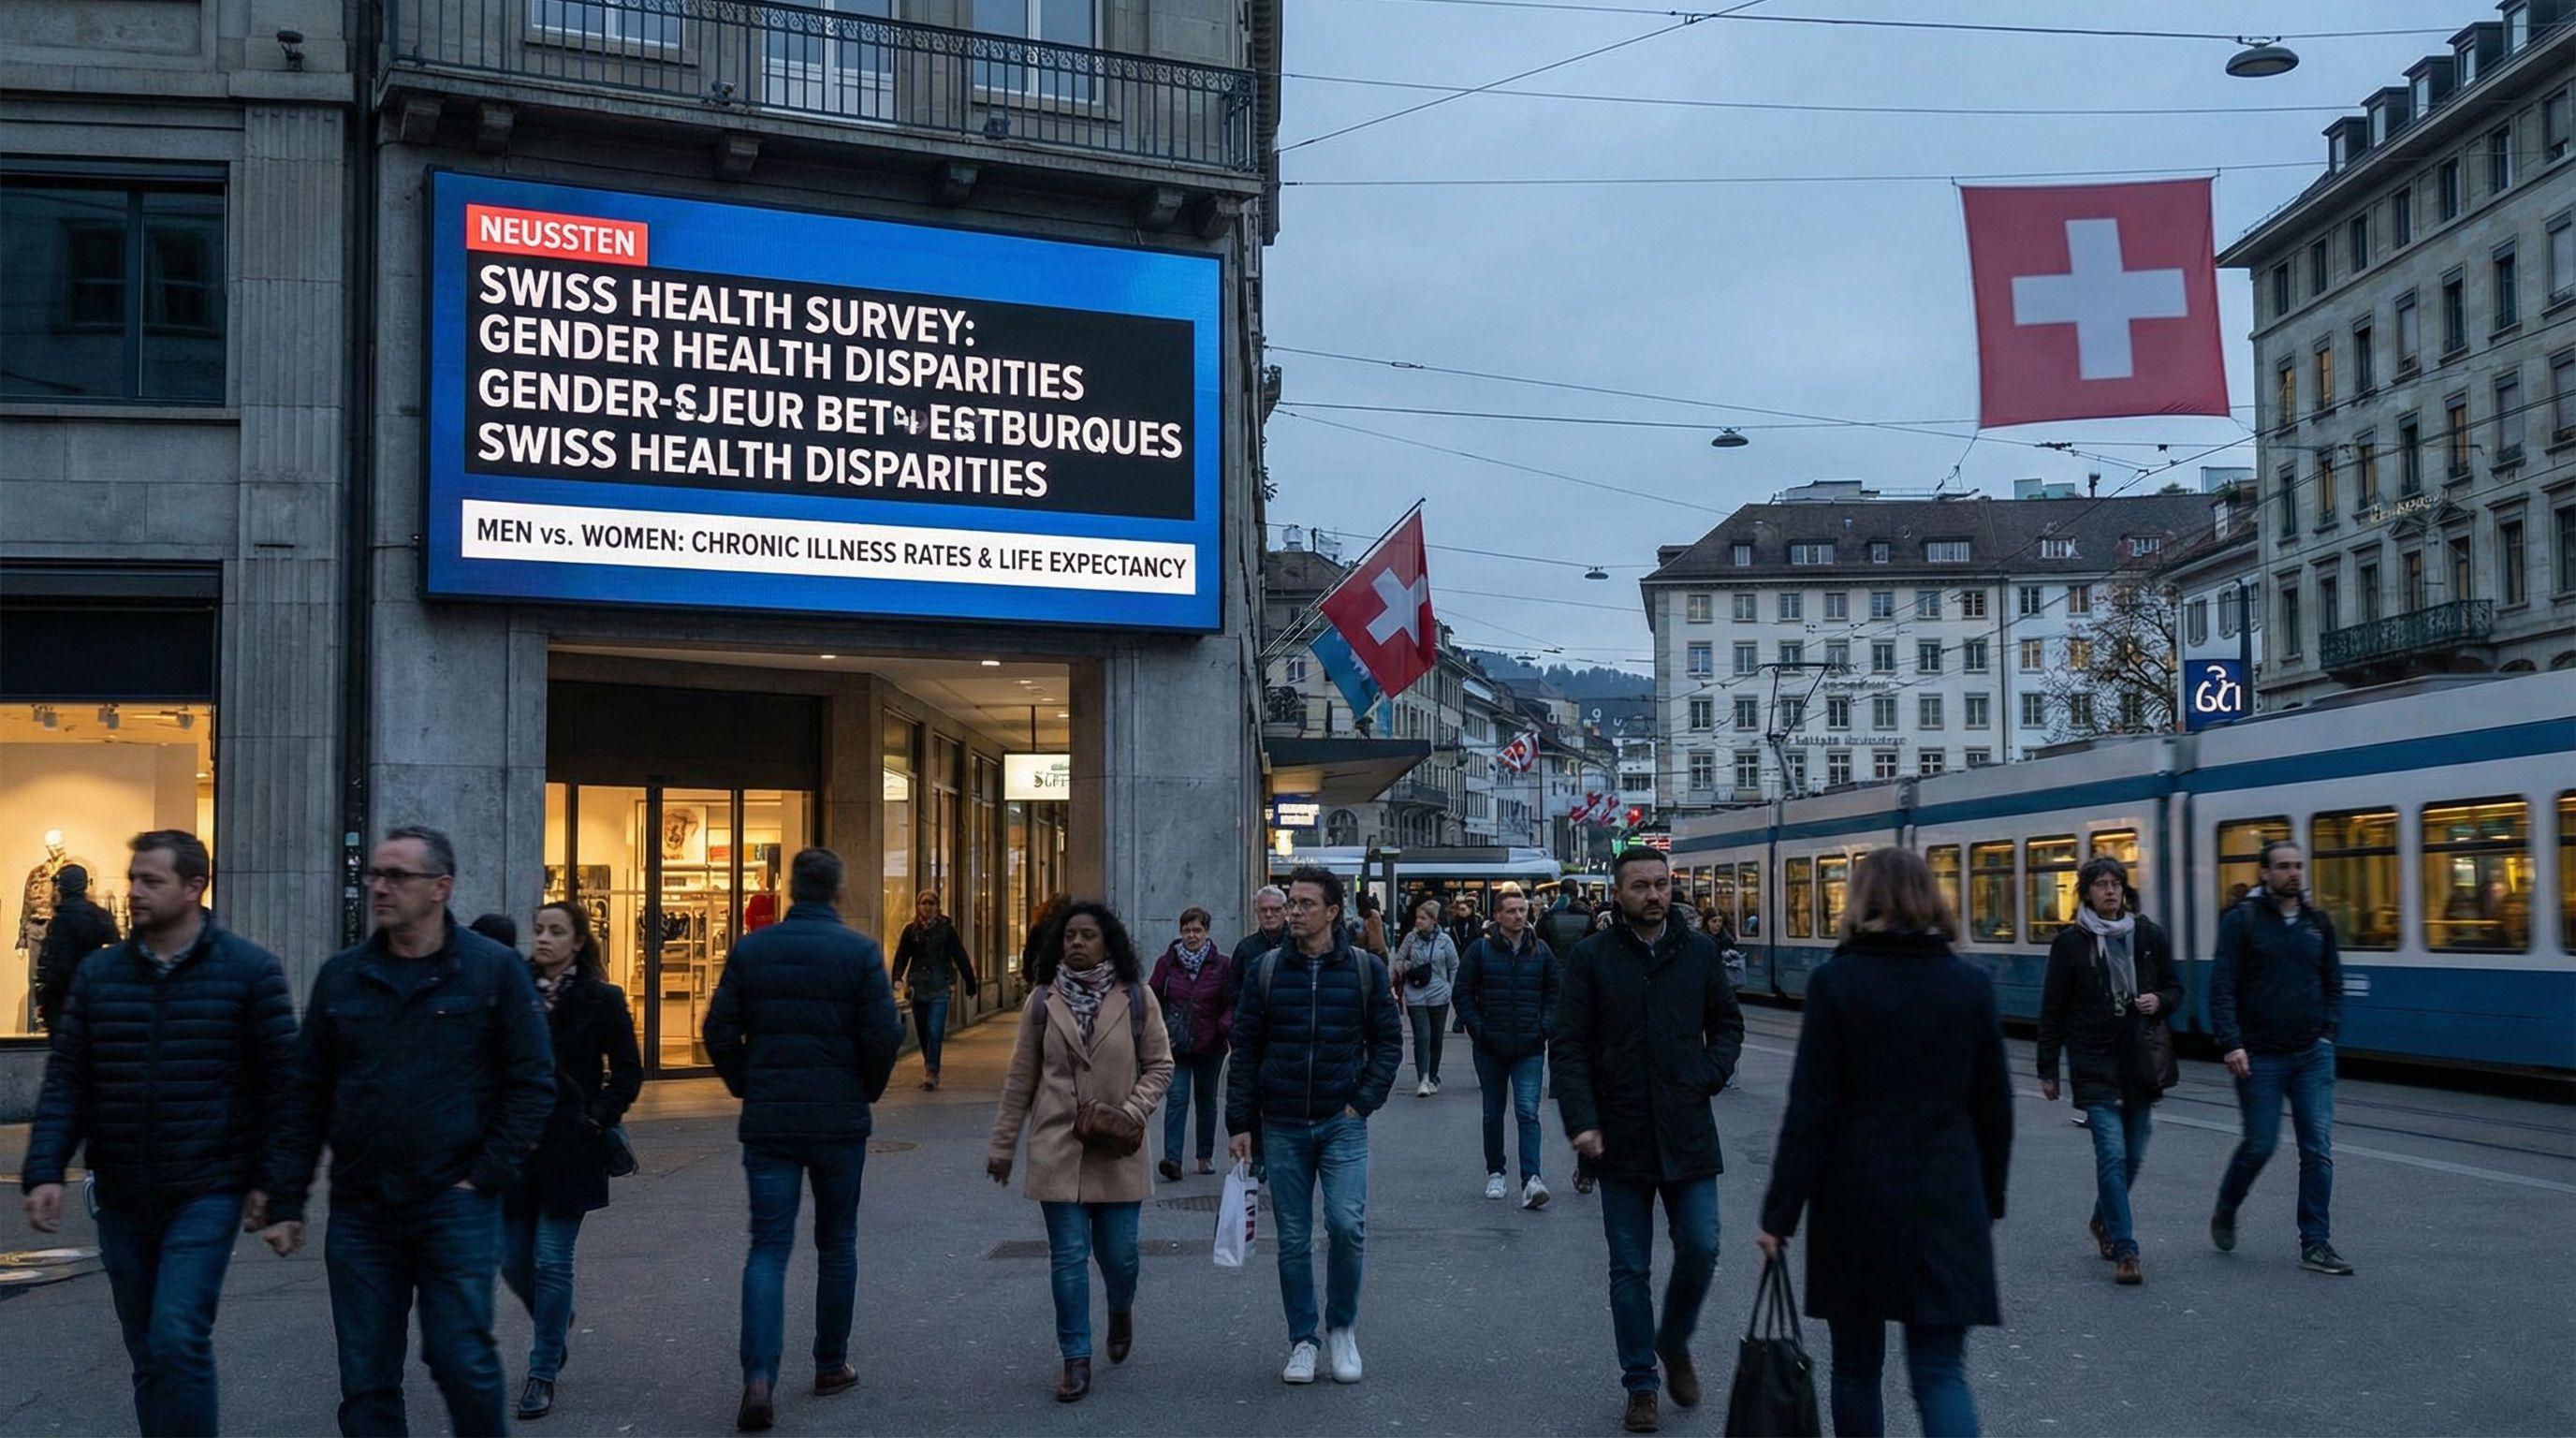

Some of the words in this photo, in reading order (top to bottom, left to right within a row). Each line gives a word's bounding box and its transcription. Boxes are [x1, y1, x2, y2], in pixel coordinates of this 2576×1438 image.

[481, 214, 635, 257] NEUSSTEN
[479, 265, 618, 315] SWISS
[633, 280, 792, 330] HEALTH
[806, 297, 975, 346] SURVEY:
[479, 315, 661, 366] GENDER
[674, 330, 831, 379] HEALTH
[846, 345, 1085, 401] DISPARITIES
[478, 422, 617, 469] SWISS
[632, 433, 792, 480] HEALTH
[807, 446, 1047, 498] DISPARITIES
[478, 519, 532, 544] MEN
[540, 528, 574, 548] vs.
[582, 525, 683, 553] WOMEN:
[692, 531, 799, 558] CHRONIC
[808, 538, 896, 564] ILLNESS
[904, 544, 972, 567] RATES
[979, 548, 992, 568] &
[1001, 550, 1043, 571] LIFE
[1050, 552, 1187, 579] EXPECTANCY
